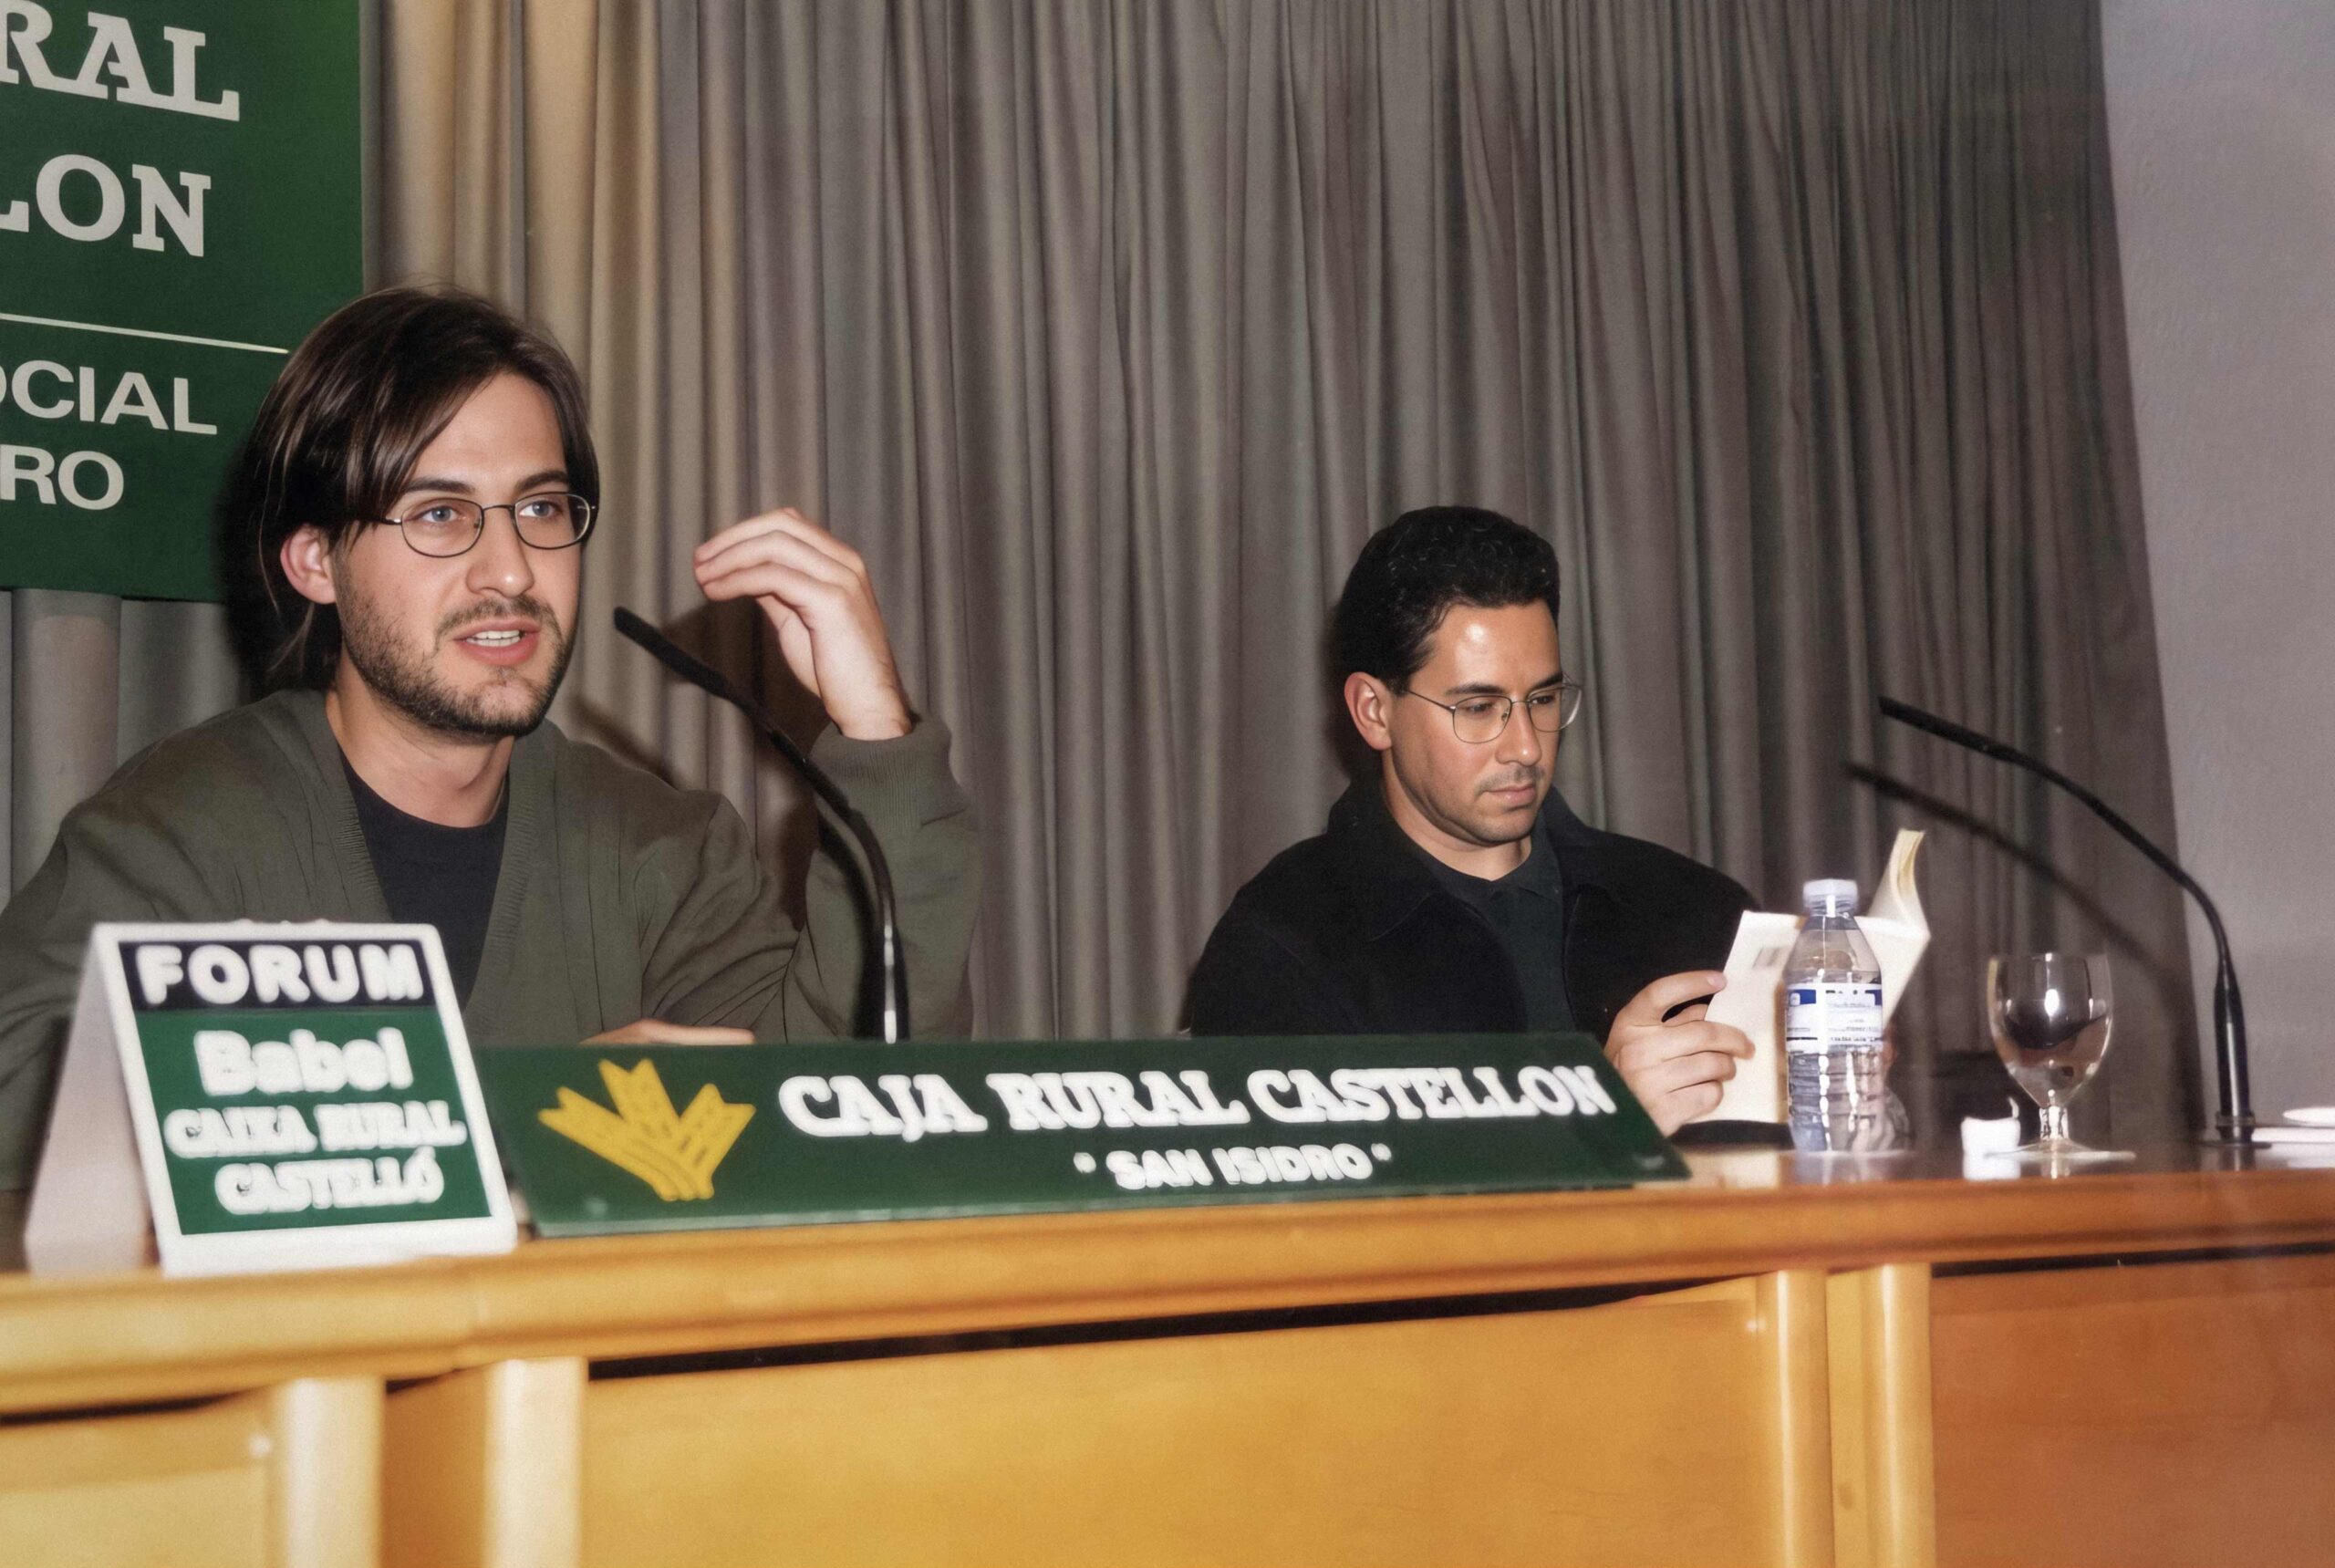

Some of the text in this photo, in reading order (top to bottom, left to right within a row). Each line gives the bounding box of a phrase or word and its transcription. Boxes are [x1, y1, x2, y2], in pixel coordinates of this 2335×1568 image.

[0, 360, 217, 434] CIAL
[136, 944, 424, 1004] FORUM
[193, 1027, 414, 1096] Babel
[779, 1065, 1617, 1142] CAJA RURAL CASTELLON
